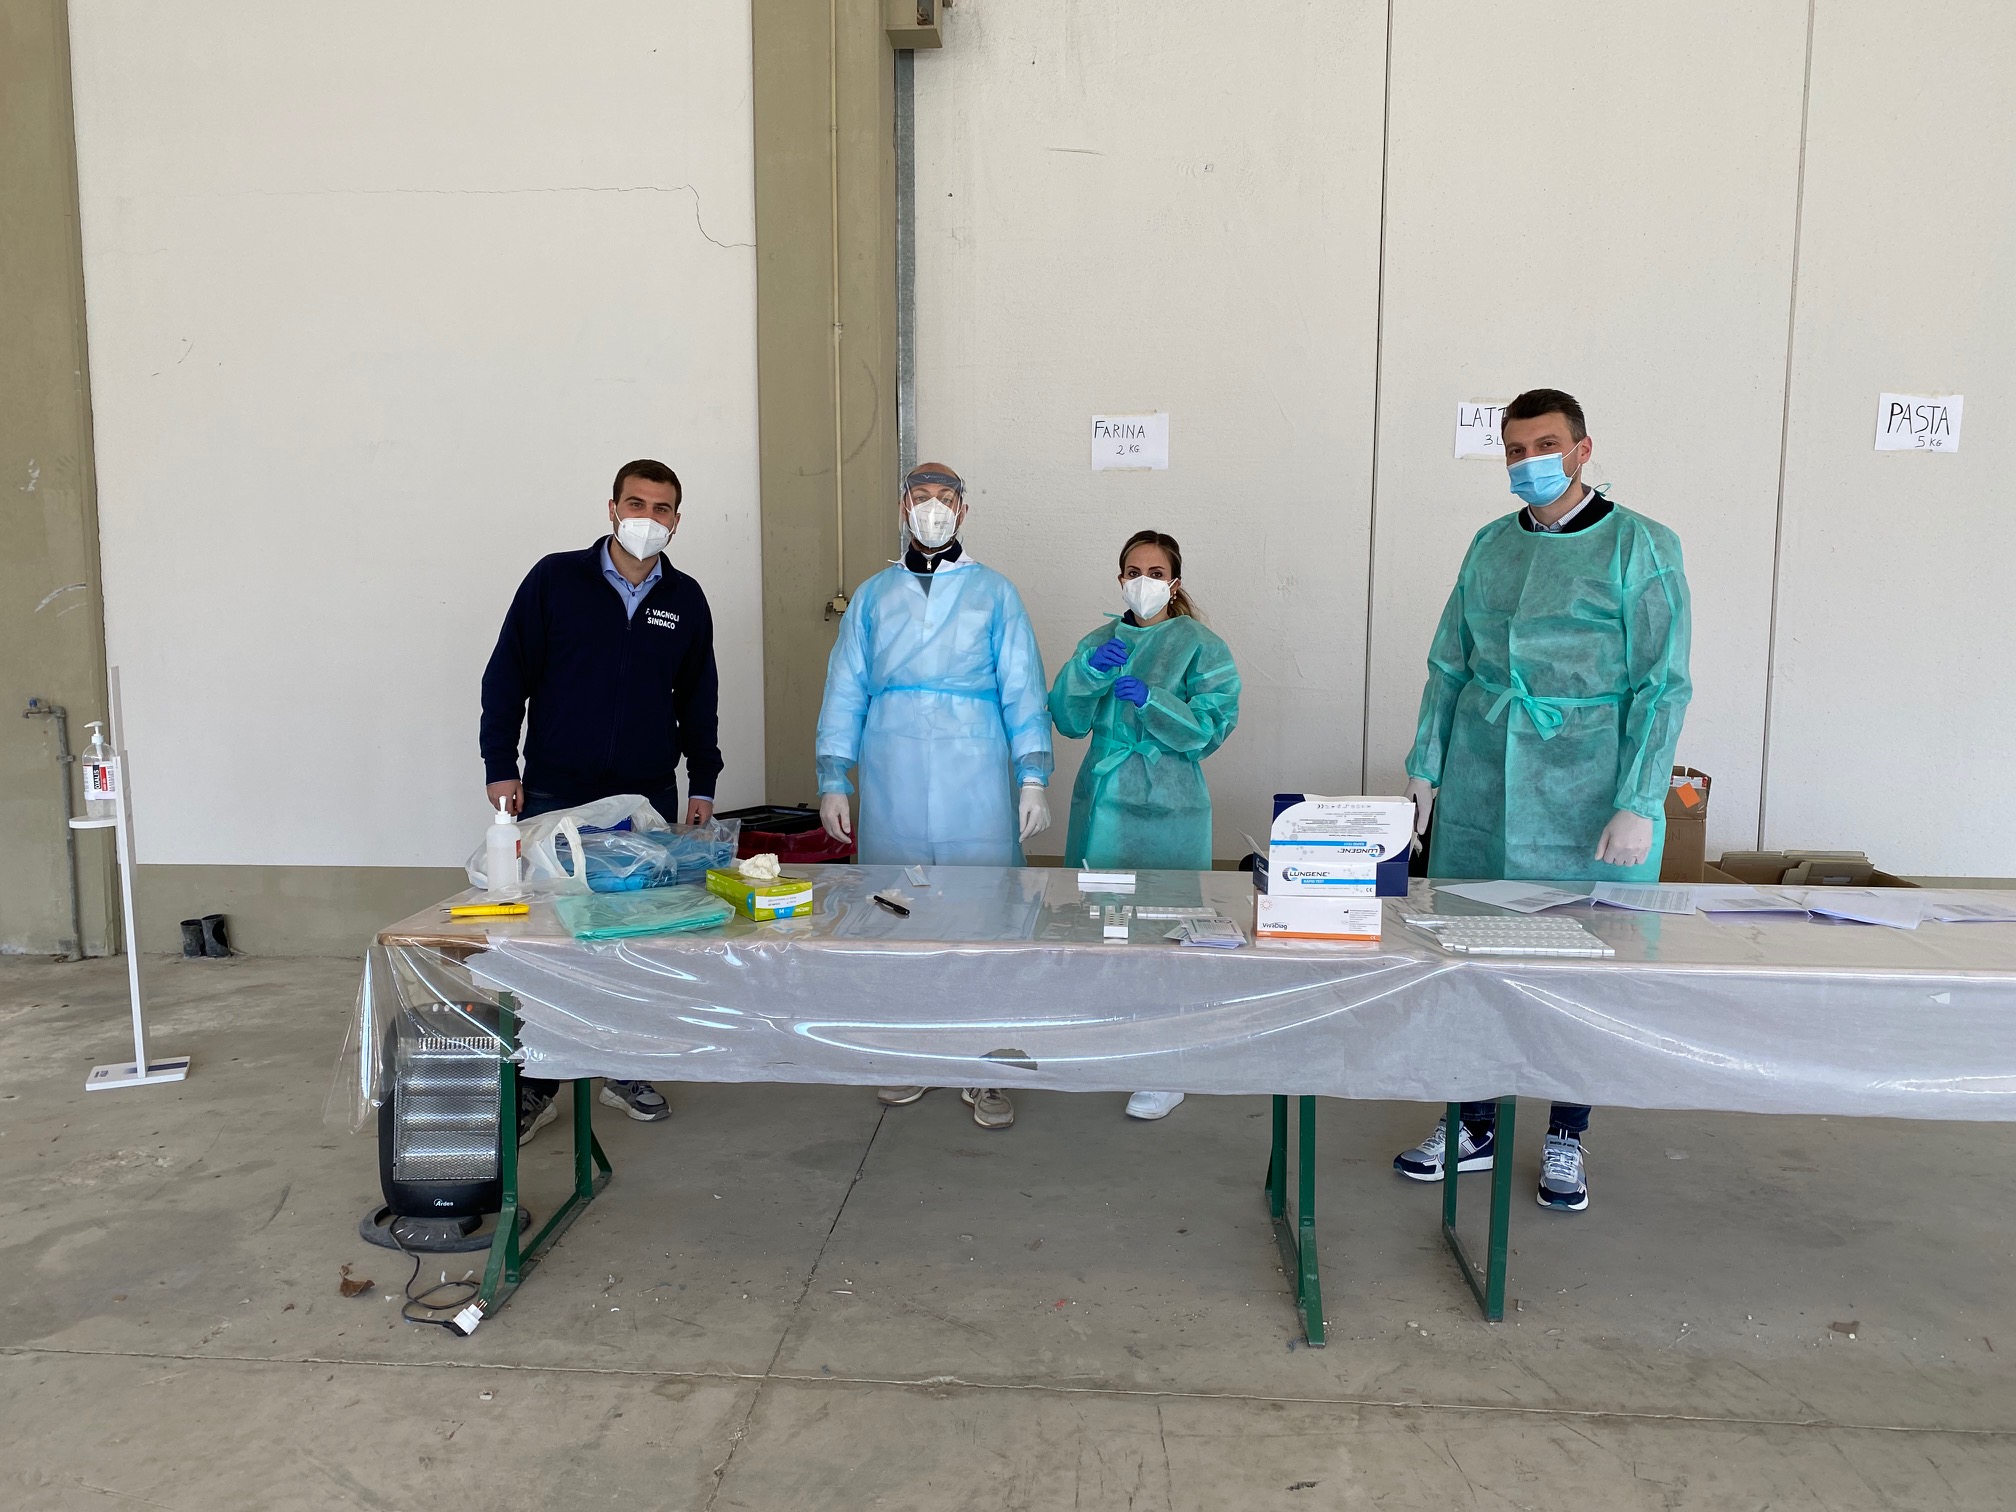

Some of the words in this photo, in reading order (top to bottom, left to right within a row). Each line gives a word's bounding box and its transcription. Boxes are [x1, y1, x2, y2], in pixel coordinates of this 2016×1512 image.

[1460, 406, 1509, 428] LATT
[1886, 402, 1950, 435] PASTA
[1094, 420, 1146, 439] FARINA
[1483, 434, 1494, 446] 3
[1914, 435, 1926, 448] 5
[1929, 437, 1943, 447] KG
[1115, 444, 1125, 455] 2
[652, 608, 680, 623] VAGNOLI
[647, 616, 676, 630] SINDACO
